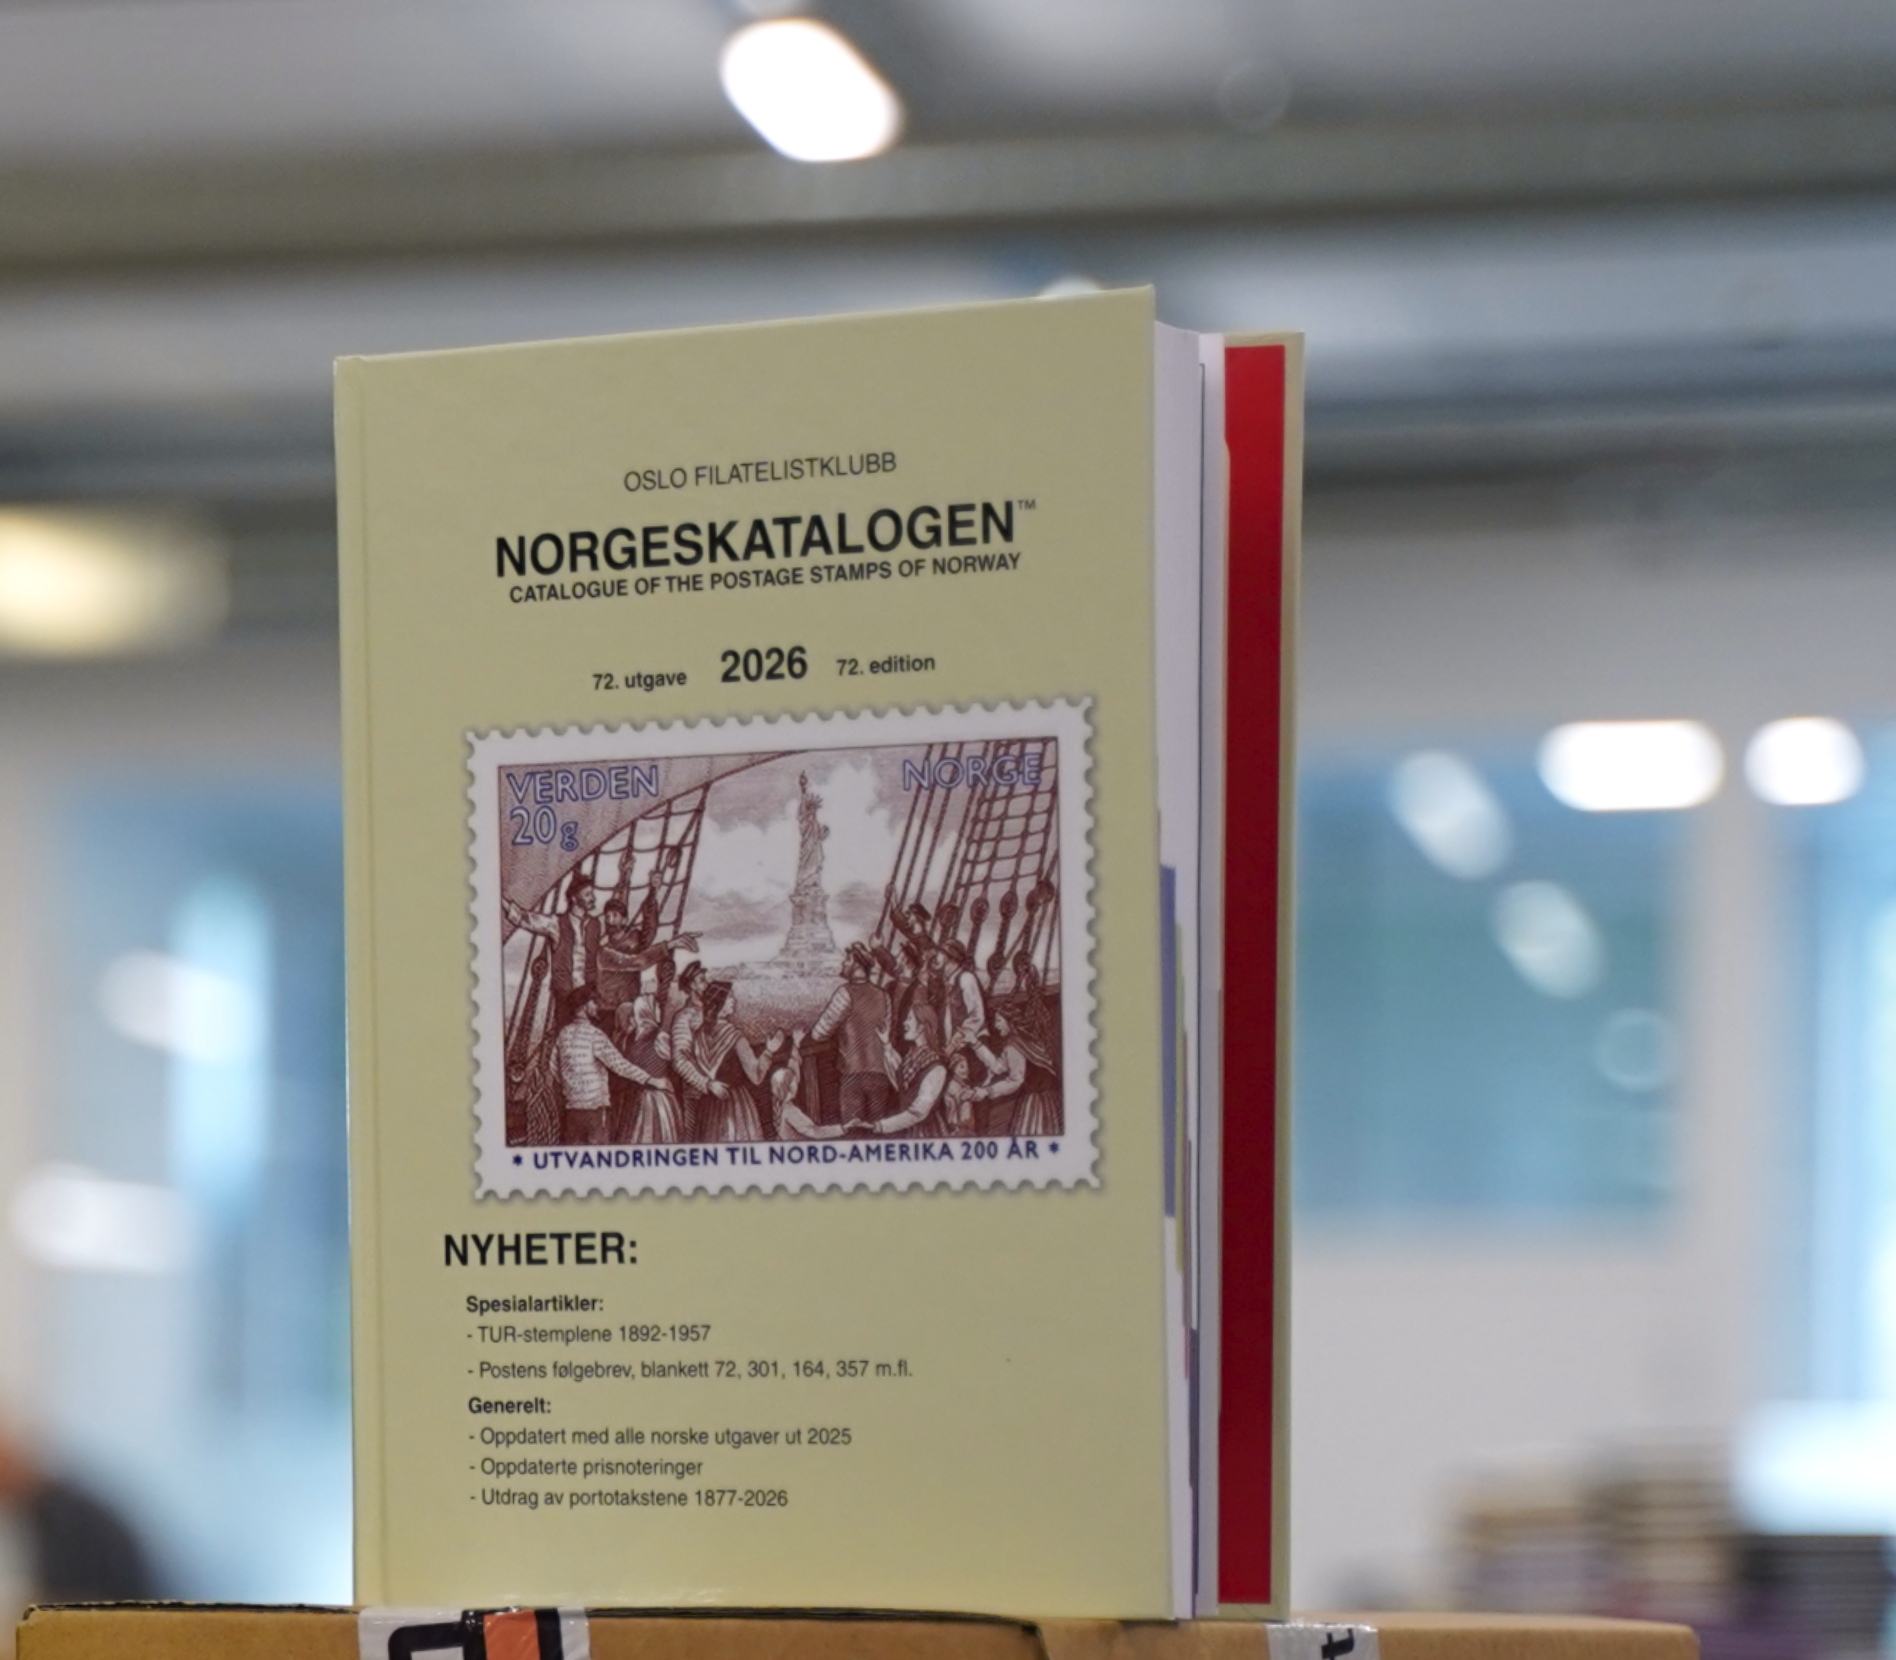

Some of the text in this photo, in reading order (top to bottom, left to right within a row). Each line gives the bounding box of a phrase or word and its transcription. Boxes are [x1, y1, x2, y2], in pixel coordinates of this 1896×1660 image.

[624, 452, 897, 492] OSLO FILATELISTKLUBB
[510, 552, 1021, 604] CATALOGUE OF THE POSTAGE STAMPS OF NORWAY
[720, 645, 809, 684] 2026
[836, 654, 936, 677] 72. edition
[592, 669, 688, 692] 72. utgave
[901, 752, 1044, 792] NORGE
[507, 765, 660, 805] VERDEN
[533, 1136, 1040, 1170] UTVANDRINGEN TIL NORD-AMERIKA 200 ÅR
[444, 1232, 638, 1267] NYHETER:
[466, 1294, 605, 1316] Spesialartikler:
[478, 1326, 612, 1346] TUR-stemplene
[619, 1325, 712, 1342] 1892-1957
[479, 1361, 548, 1379] Postens
[553, 1361, 636, 1383] følgebrev,
[641, 1360, 709, 1379] blankett
[715, 1361, 742, 1380] 72,
[747, 1361, 787, 1380] 301,
[793, 1361, 831, 1380] 164,
[836, 1360, 870, 1378] 357
[875, 1359, 914, 1378] m.fl.
[468, 1396, 551, 1414] Generelt:
[480, 1427, 567, 1448] Oppdatert
[572, 1428, 609, 1445] med
[615, 1428, 645, 1445] alle
[650, 1428, 709, 1445] norske
[715, 1429, 780, 1450] utgaver
[785, 1429, 803, 1446] ut
[807, 1428, 852, 1445] 2025
[480, 1458, 578, 1479] Oppdaterte
[583, 1458, 703, 1480] prisnoteringer
[482, 1488, 539, 1510] Utdrag
[544, 1491, 564, 1506] av
[569, 1488, 688, 1509] portotakstene
[695, 1489, 789, 1507] 1877-2026
